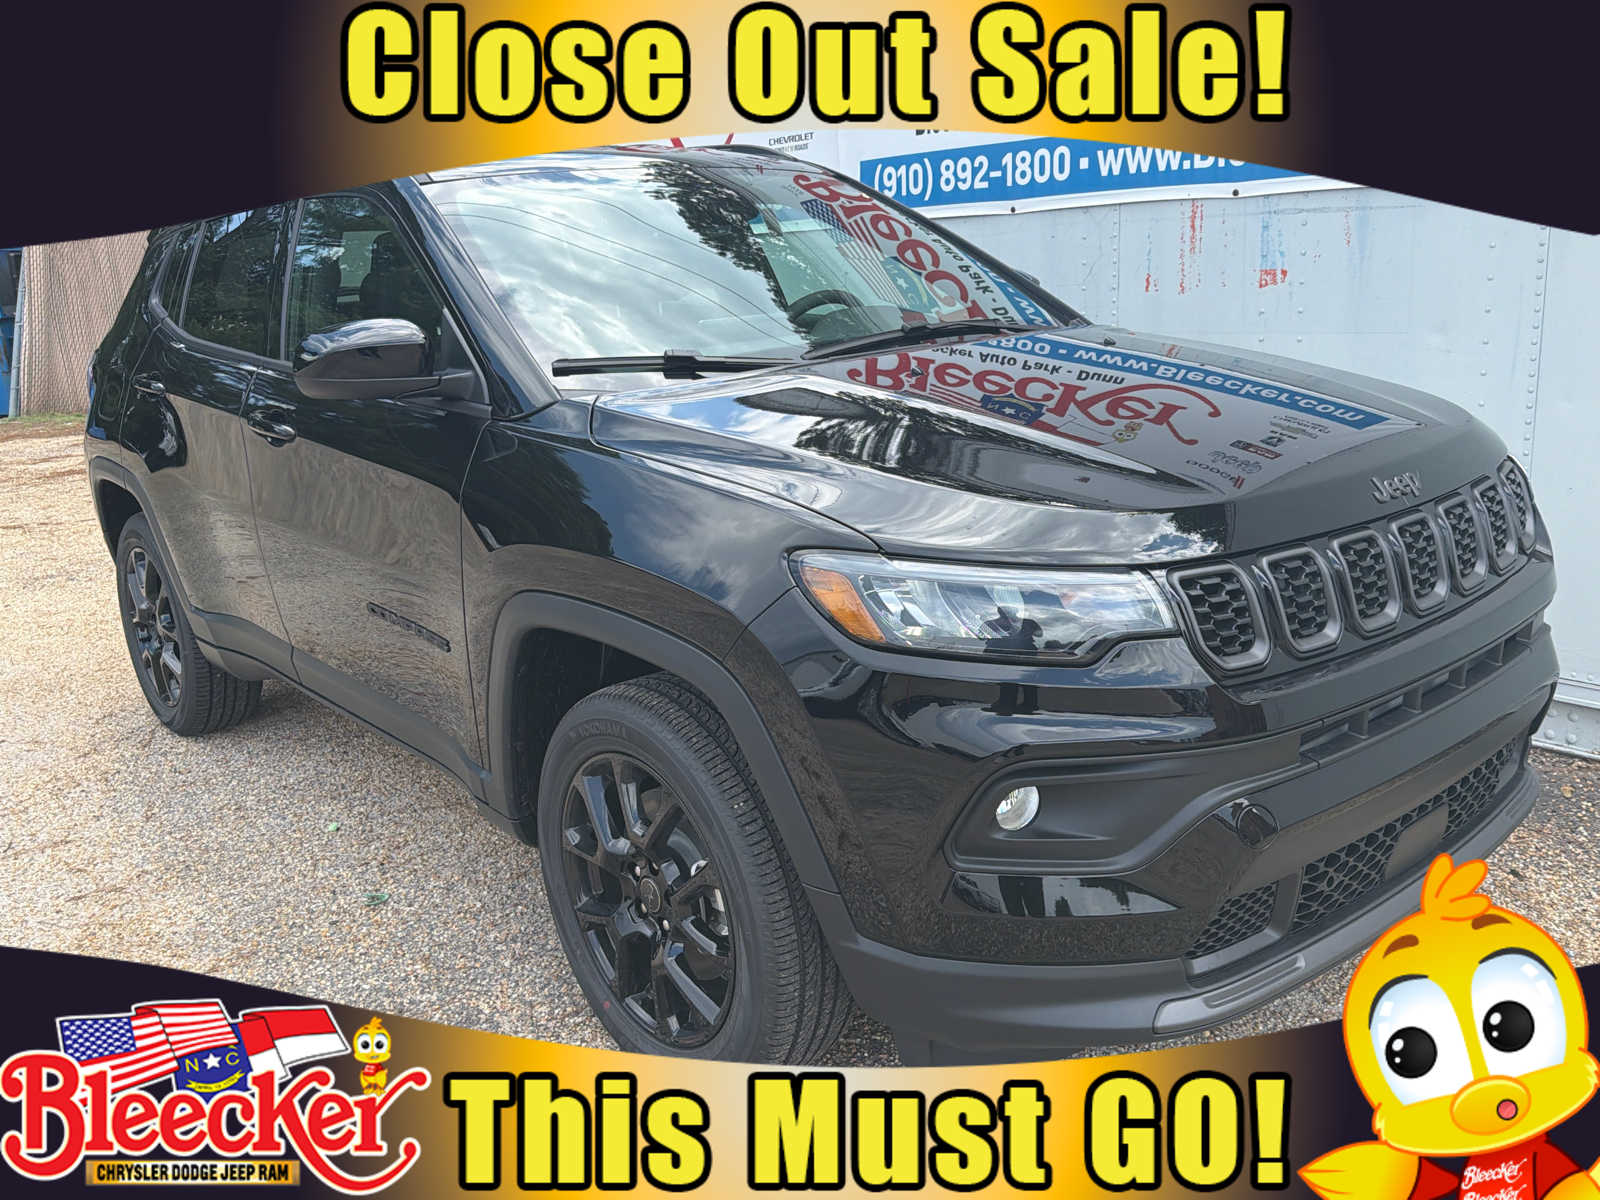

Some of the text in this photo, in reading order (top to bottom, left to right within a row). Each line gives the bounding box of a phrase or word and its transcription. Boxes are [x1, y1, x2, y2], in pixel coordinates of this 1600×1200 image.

[768, 132, 815, 147] CHEVROLET
[874, 157, 933, 201] (910)
[939, 145, 1071, 192] 892-1800
[1369, 471, 1423, 503] Jeep
